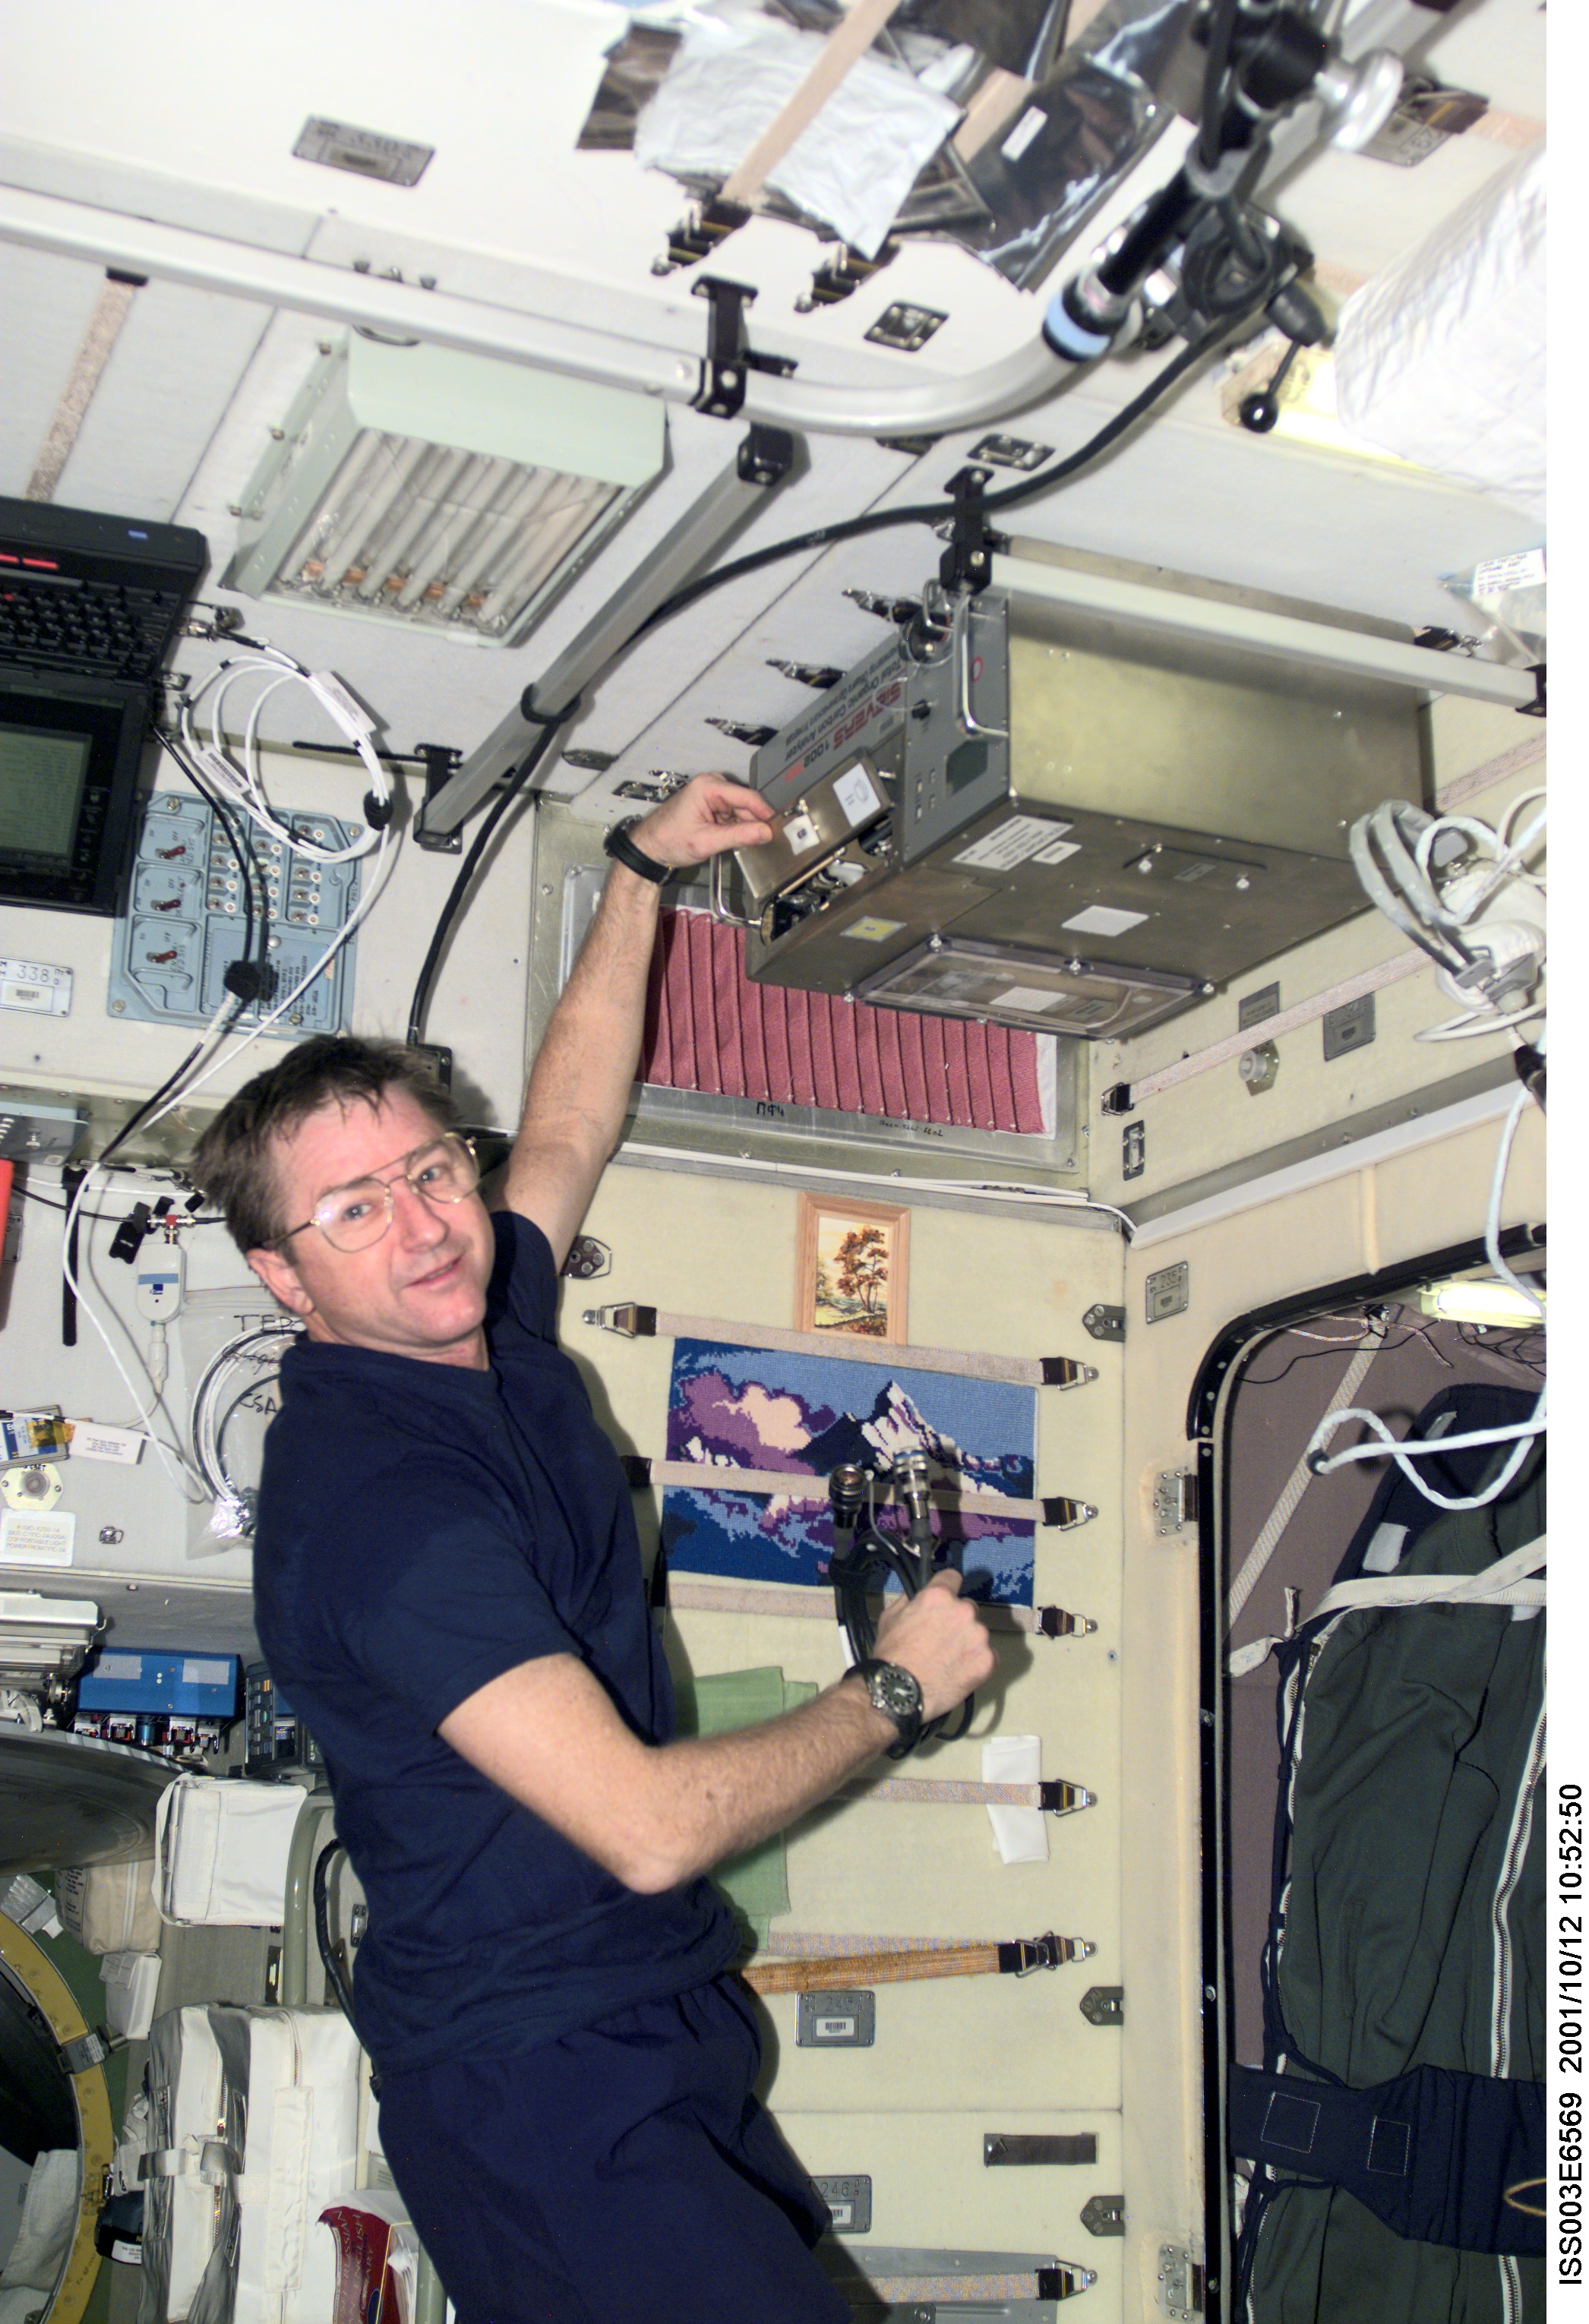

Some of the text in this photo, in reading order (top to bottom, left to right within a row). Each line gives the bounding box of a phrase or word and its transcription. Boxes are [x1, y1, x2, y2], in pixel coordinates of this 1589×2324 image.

[835, 681, 900, 750] SIEVERS
[17, 965, 49, 982] 338
[826, 1997, 853, 2012] 245
[820, 2181, 850, 2197] 246
